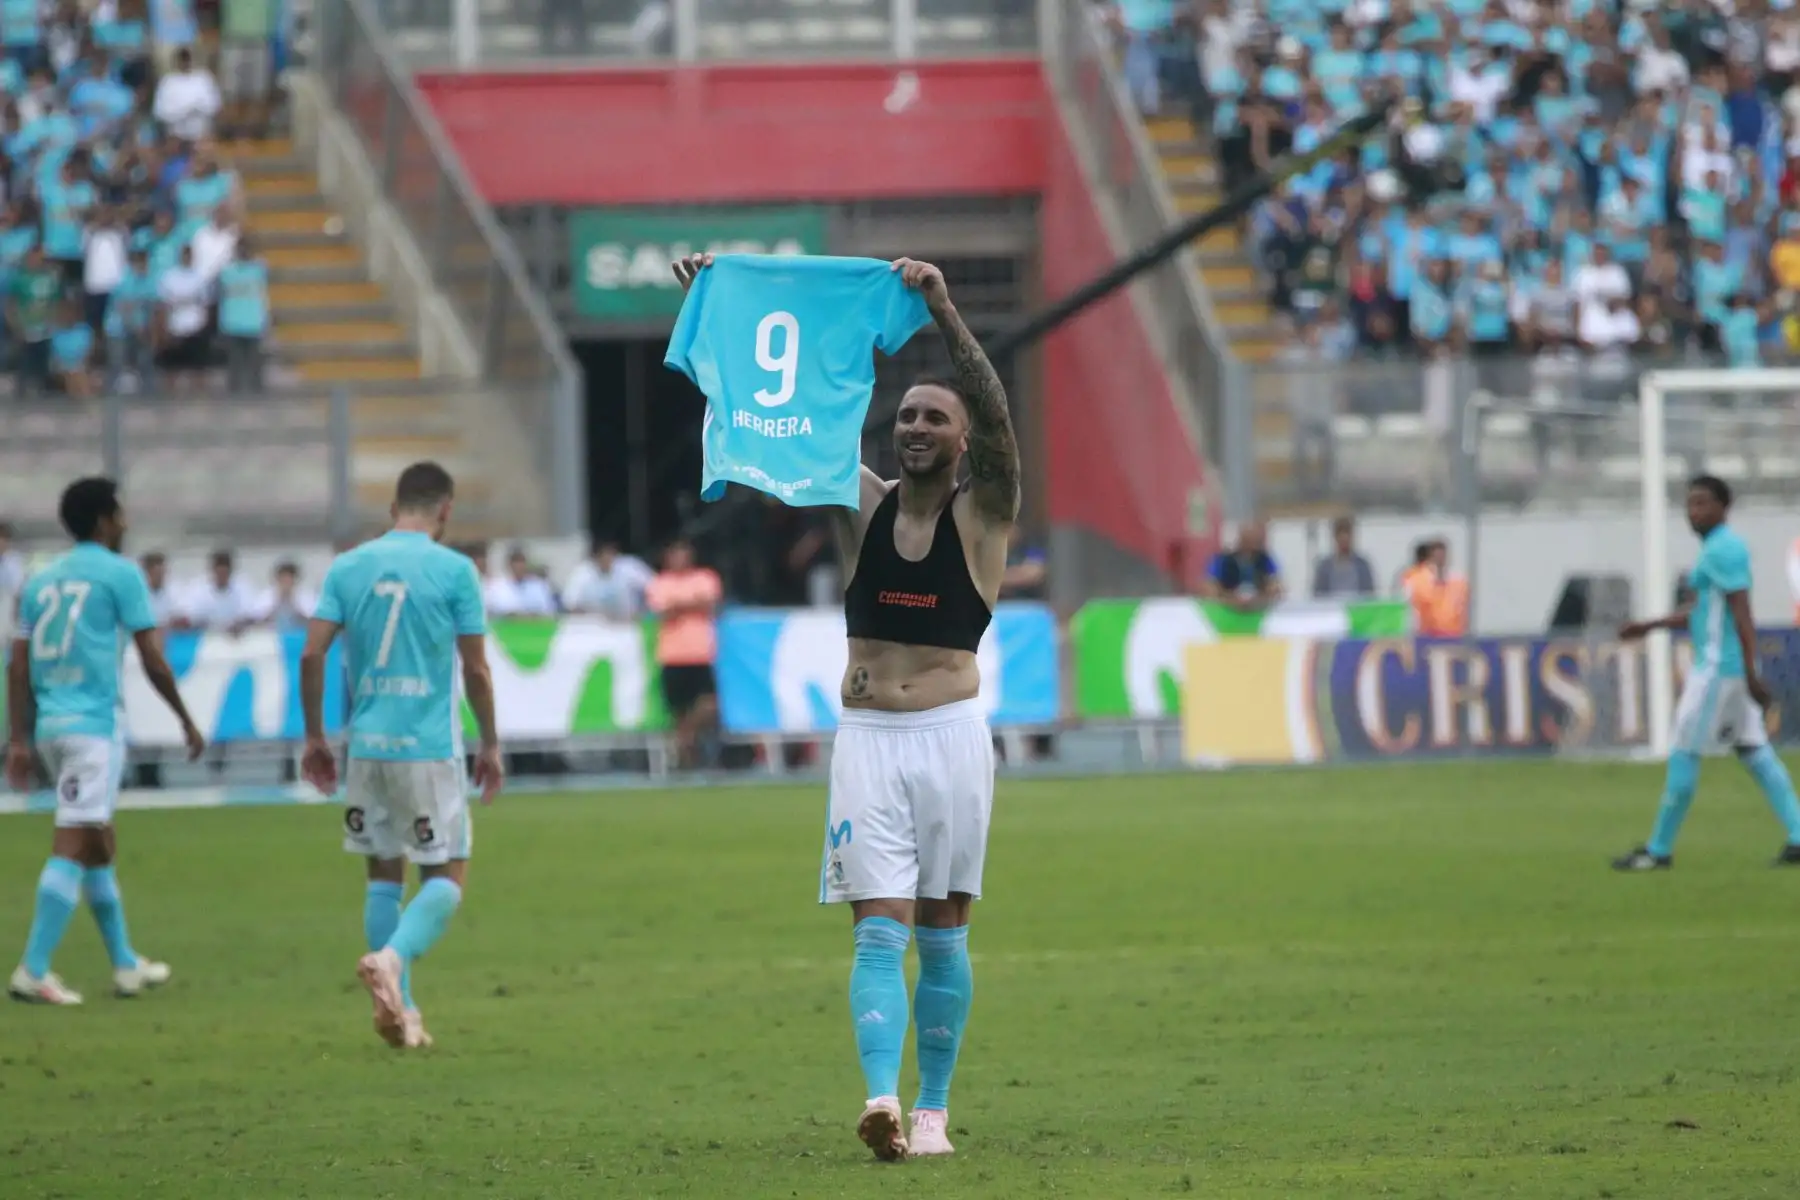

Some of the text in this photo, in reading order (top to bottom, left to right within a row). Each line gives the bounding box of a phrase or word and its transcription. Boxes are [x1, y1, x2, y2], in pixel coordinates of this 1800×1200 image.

[586, 240, 806, 289] SAL
[753, 310, 800, 408] 9
[732, 409, 812, 438] HERRERA
[33, 579, 91, 662] 27
[374, 580, 406, 669] 7
[1354, 637, 1782, 754] CRIST
